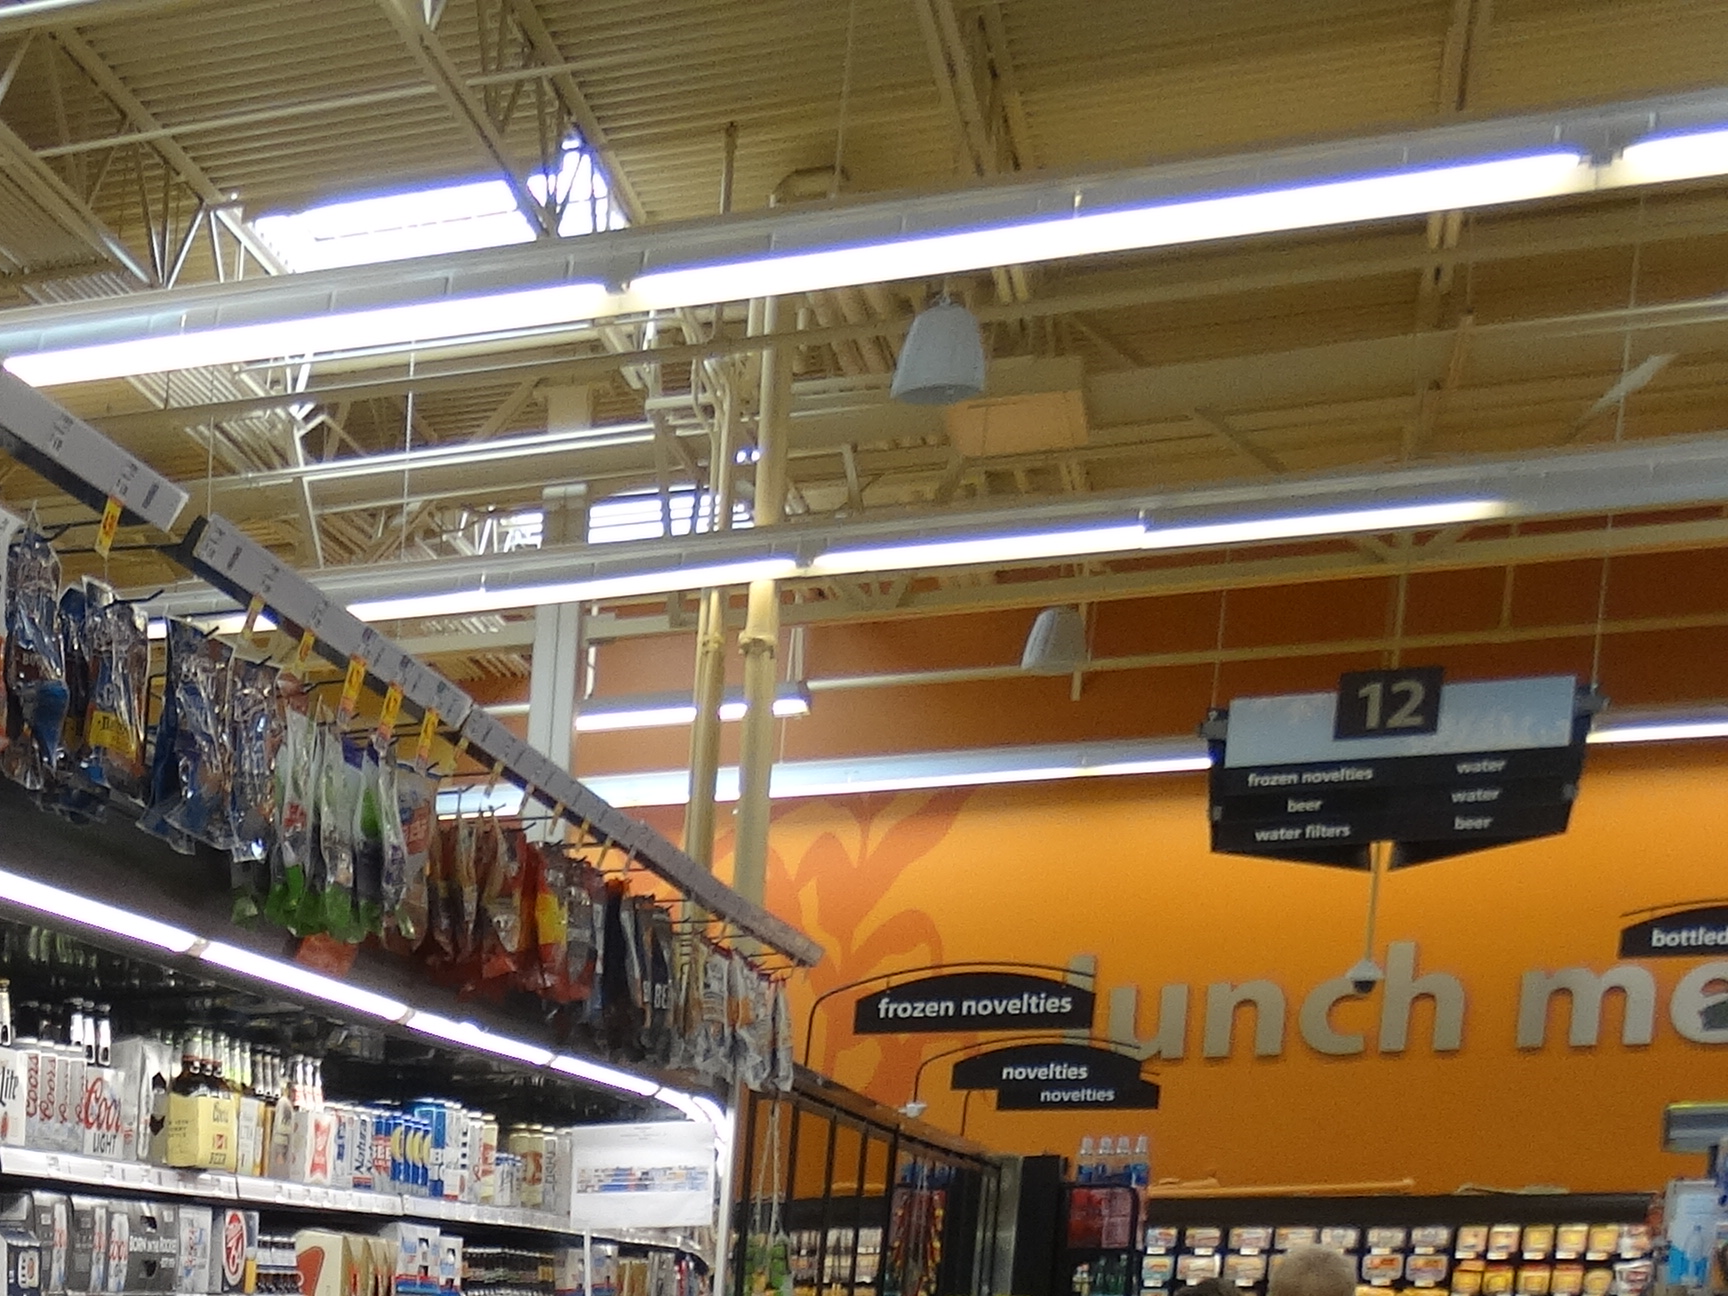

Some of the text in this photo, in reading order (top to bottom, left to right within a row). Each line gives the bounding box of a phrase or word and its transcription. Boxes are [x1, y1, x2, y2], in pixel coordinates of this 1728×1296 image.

[1358, 678, 1426, 730] 12
[1456, 758, 1507, 774] water
[1247, 766, 1374, 787] frozen novelties
[1451, 788, 1500, 803] water
[1286, 797, 1323, 813] beer
[1453, 816, 1493, 830] beer
[1254, 823, 1352, 842] water filters
[877, 993, 1074, 1020] frozen novelties
[1001, 1062, 1089, 1082] novelties
[1039, 1086, 1116, 1103] novelties
